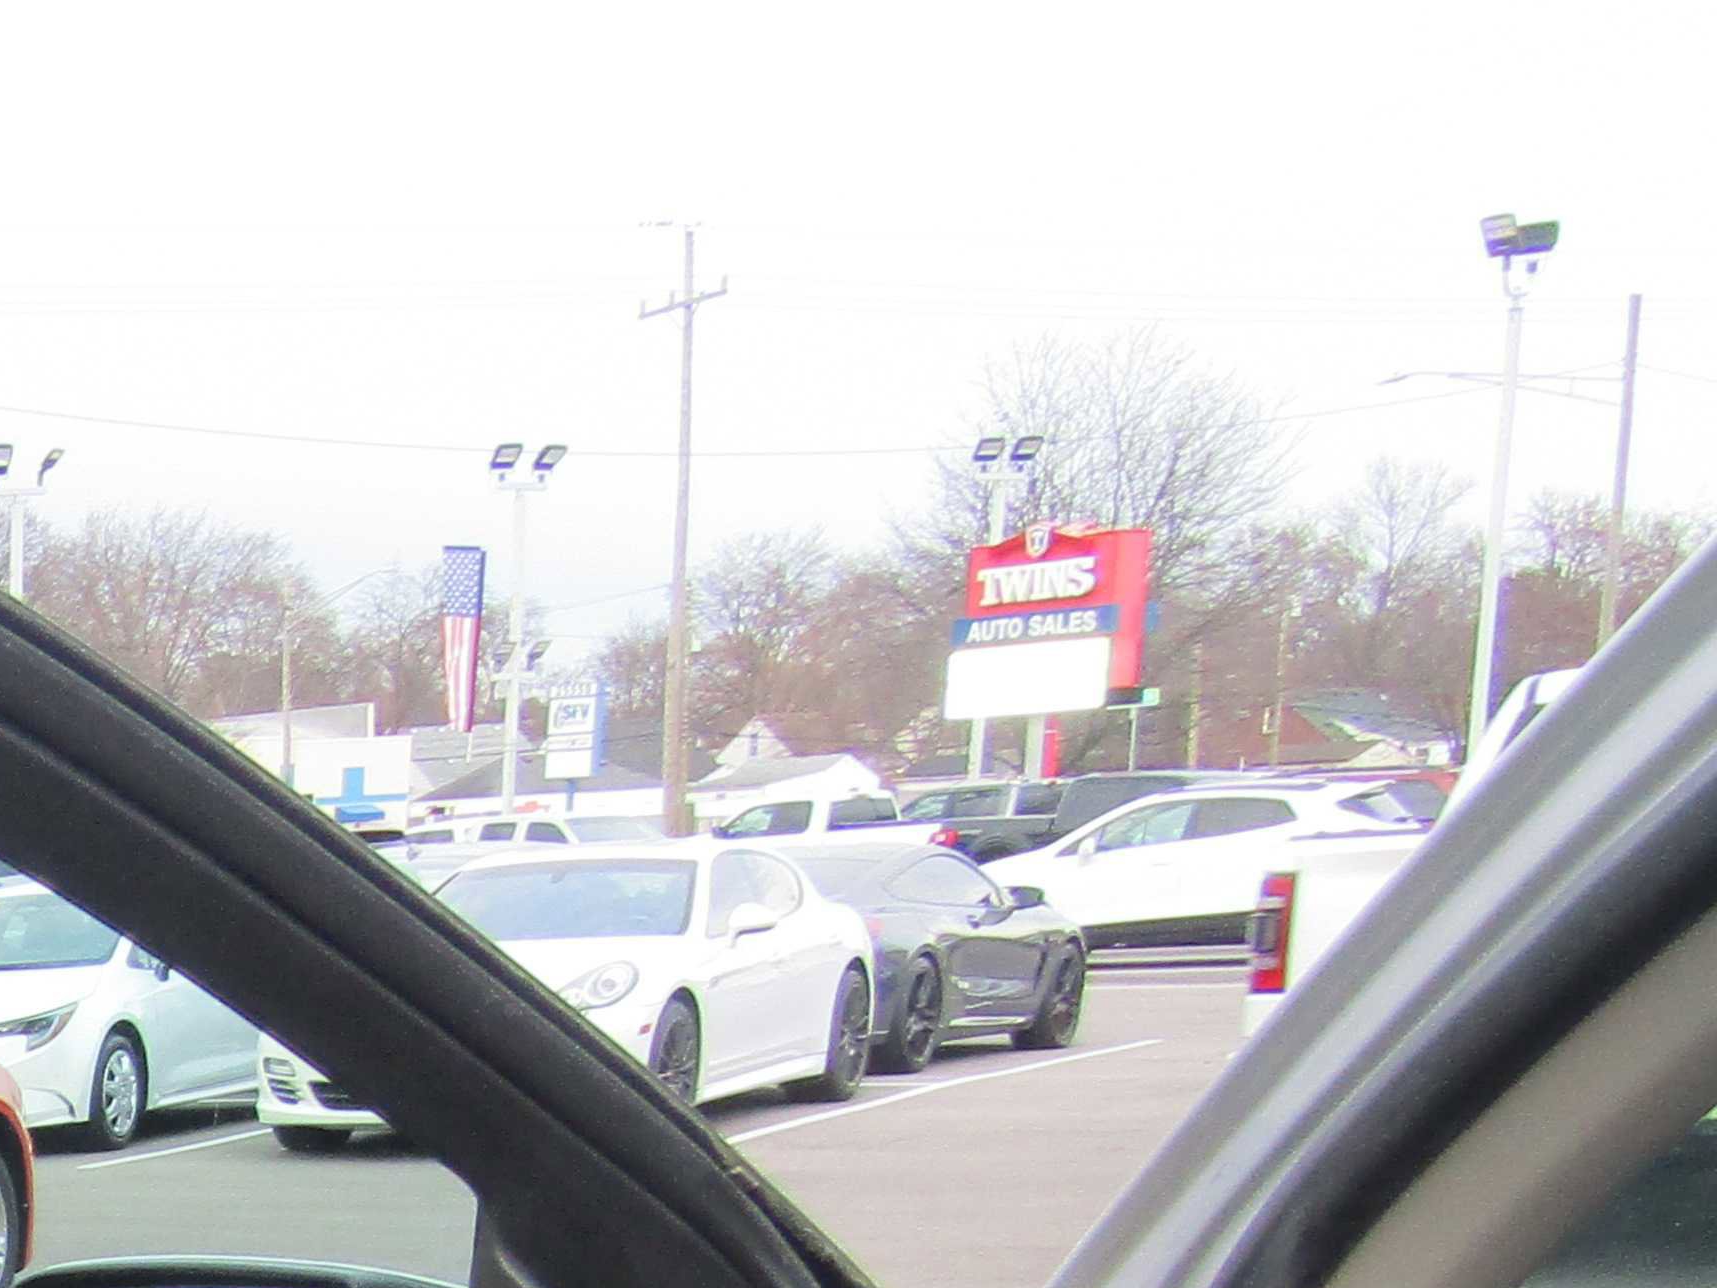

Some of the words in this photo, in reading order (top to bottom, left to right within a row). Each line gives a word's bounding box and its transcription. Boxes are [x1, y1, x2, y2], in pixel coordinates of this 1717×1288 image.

[976, 556, 1097, 607] TWINS
[965, 619, 1024, 643] AUTO
[1027, 610, 1097, 637] SALES
